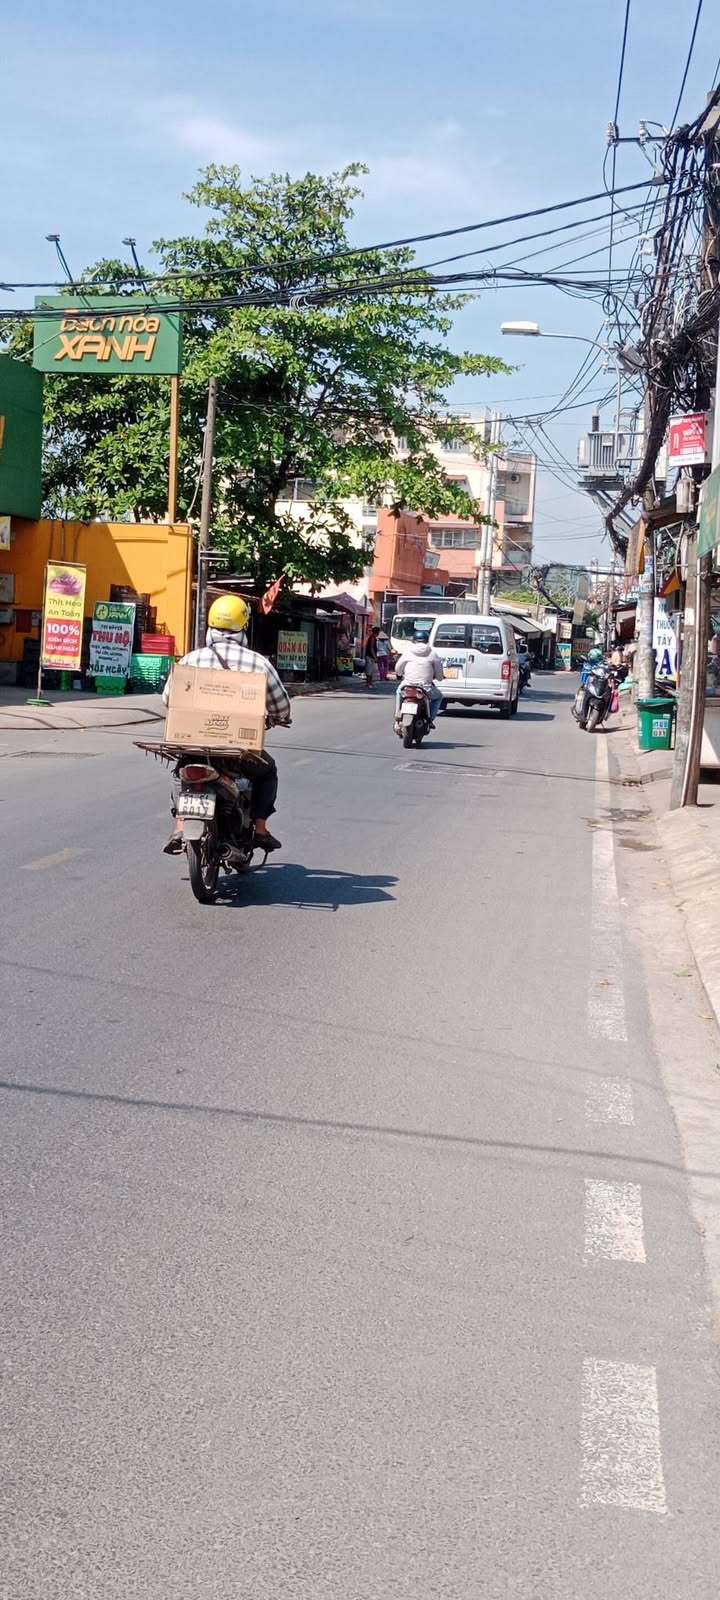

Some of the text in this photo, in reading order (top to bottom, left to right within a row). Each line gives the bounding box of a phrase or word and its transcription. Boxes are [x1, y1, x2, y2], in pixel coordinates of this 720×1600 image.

[59, 309, 116, 333] Bch
[54, 335, 157, 362] XANH
[47, 623, 80, 636] 100%
[92, 629, 130, 647] THU HỘ
